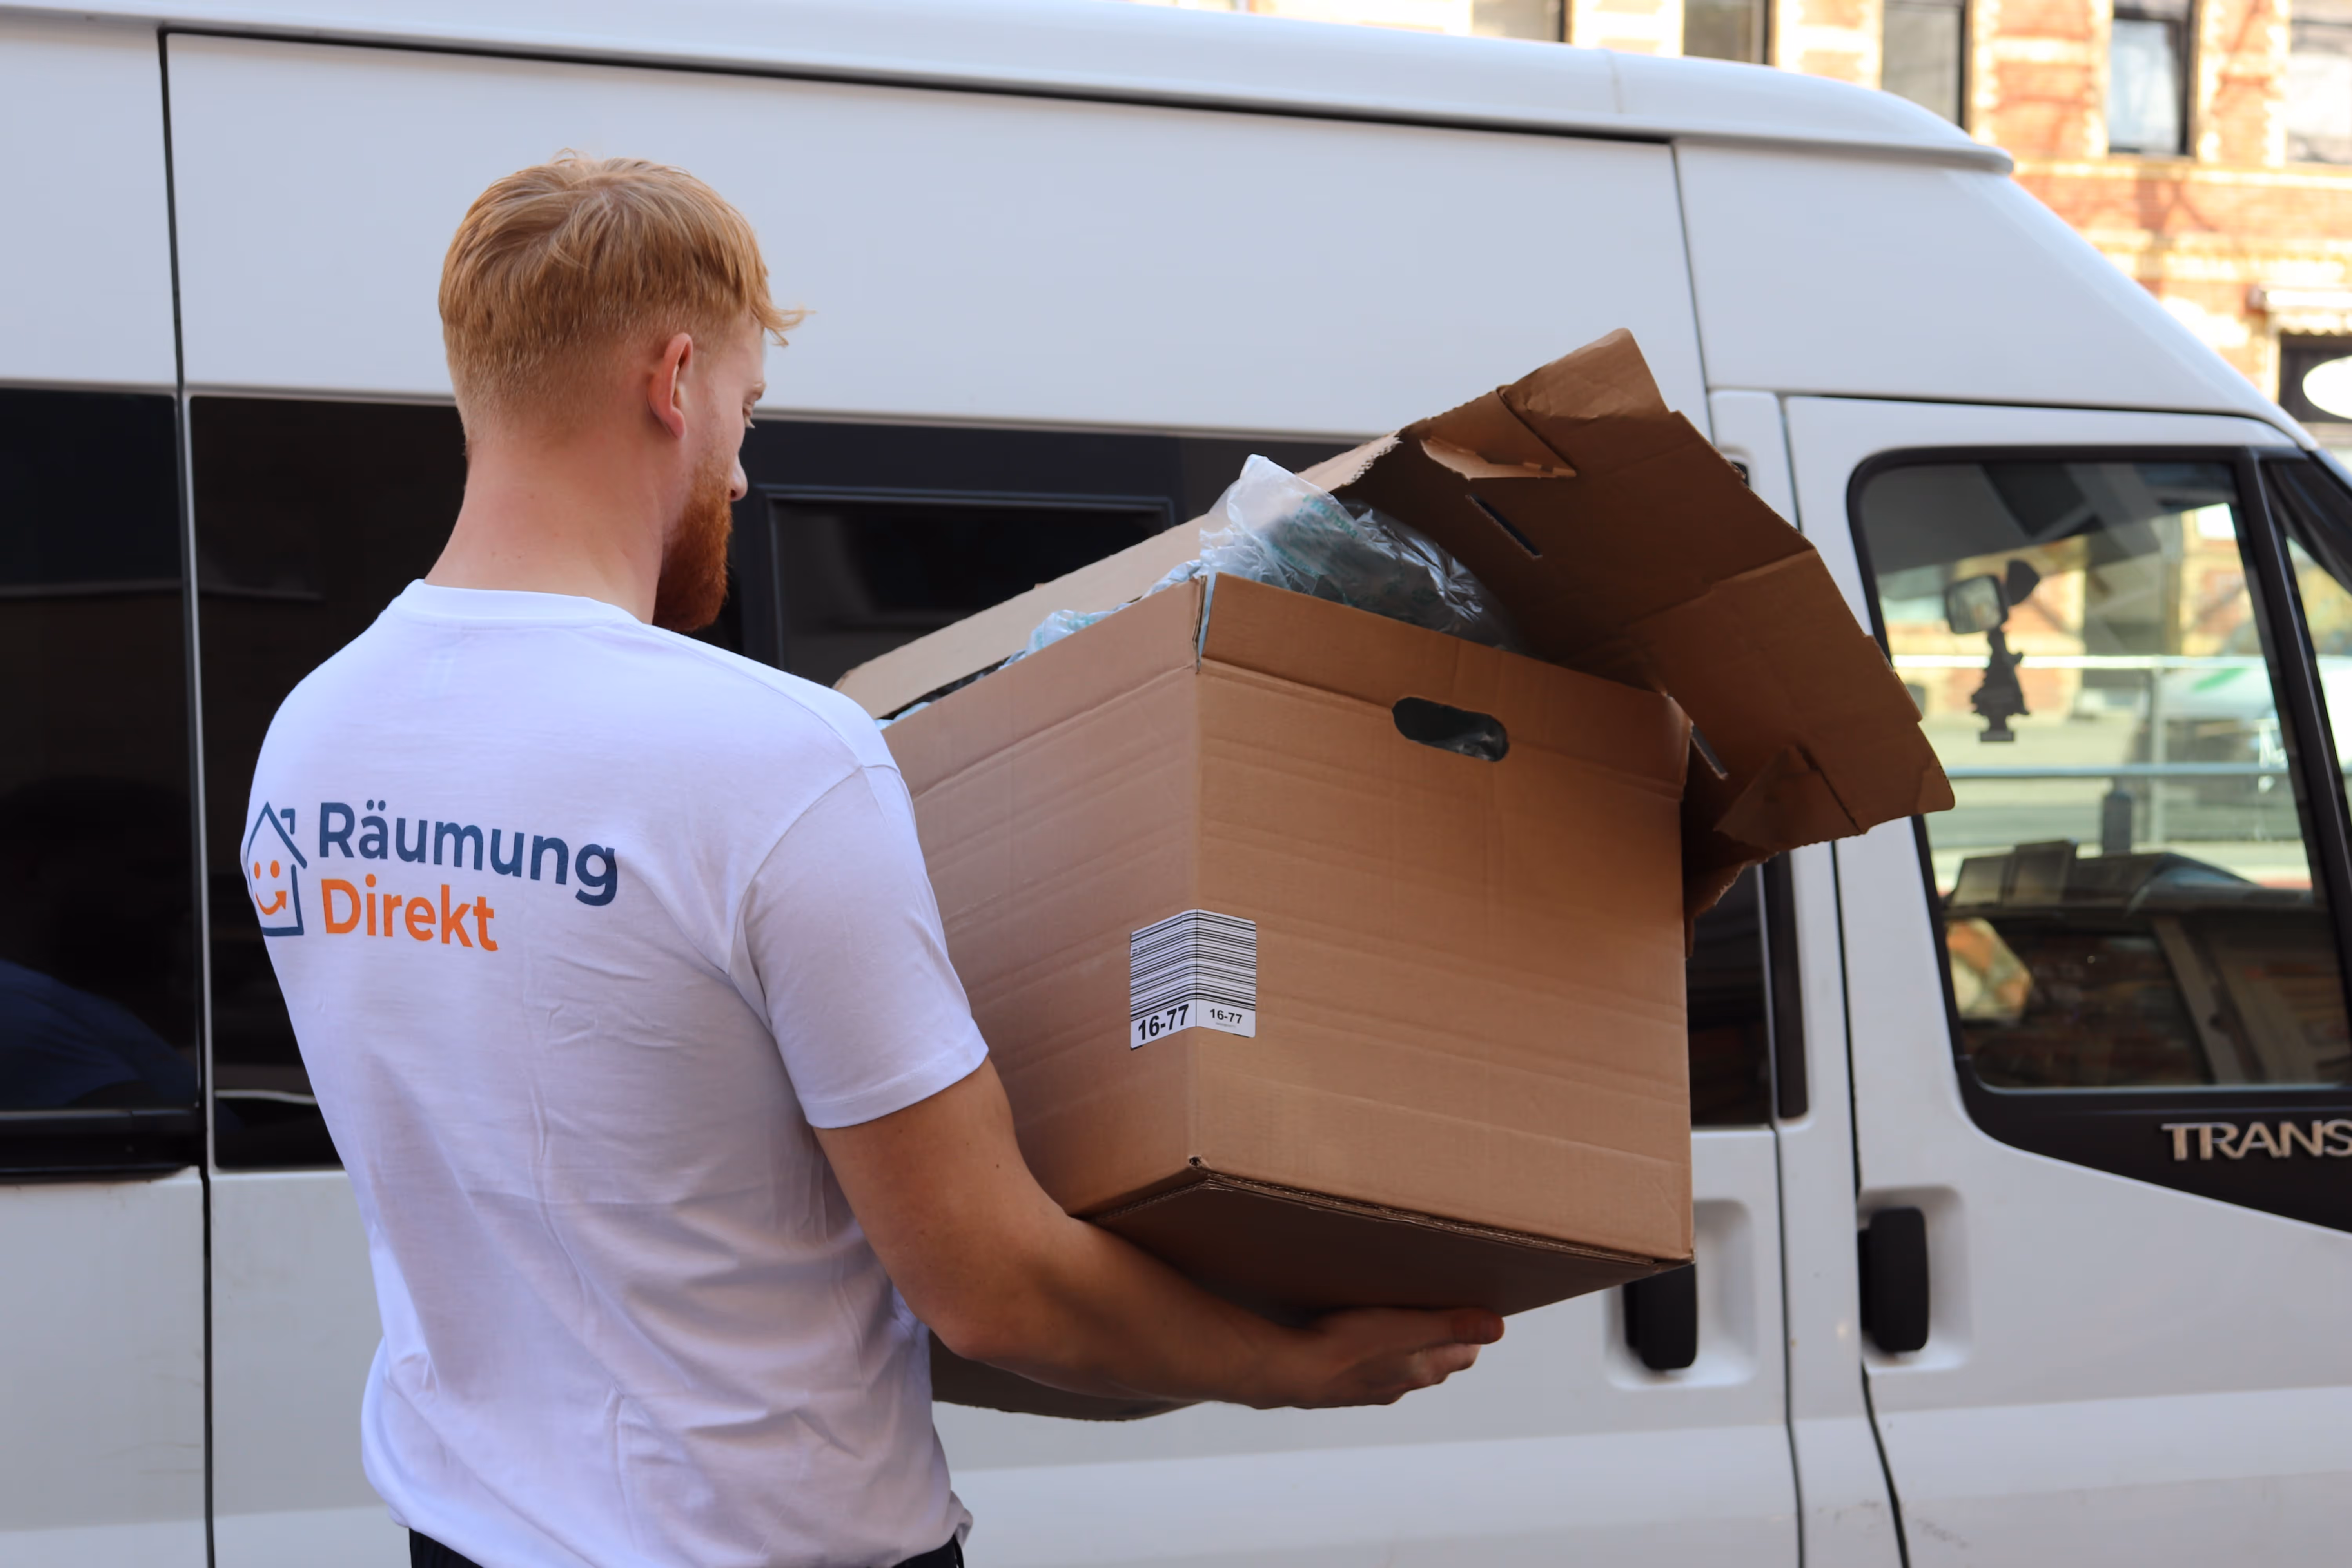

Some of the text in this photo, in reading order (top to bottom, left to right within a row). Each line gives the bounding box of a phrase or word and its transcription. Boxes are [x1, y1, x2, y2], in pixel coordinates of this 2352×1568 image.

[319, 800, 618, 906] Räumung
[321, 874, 498, 951] Direkt
[1138, 1004, 1189, 1040] 16-77
[1210, 1008, 1243, 1024] 16-77
[2161, 1118, 2352, 1161] TRANS
